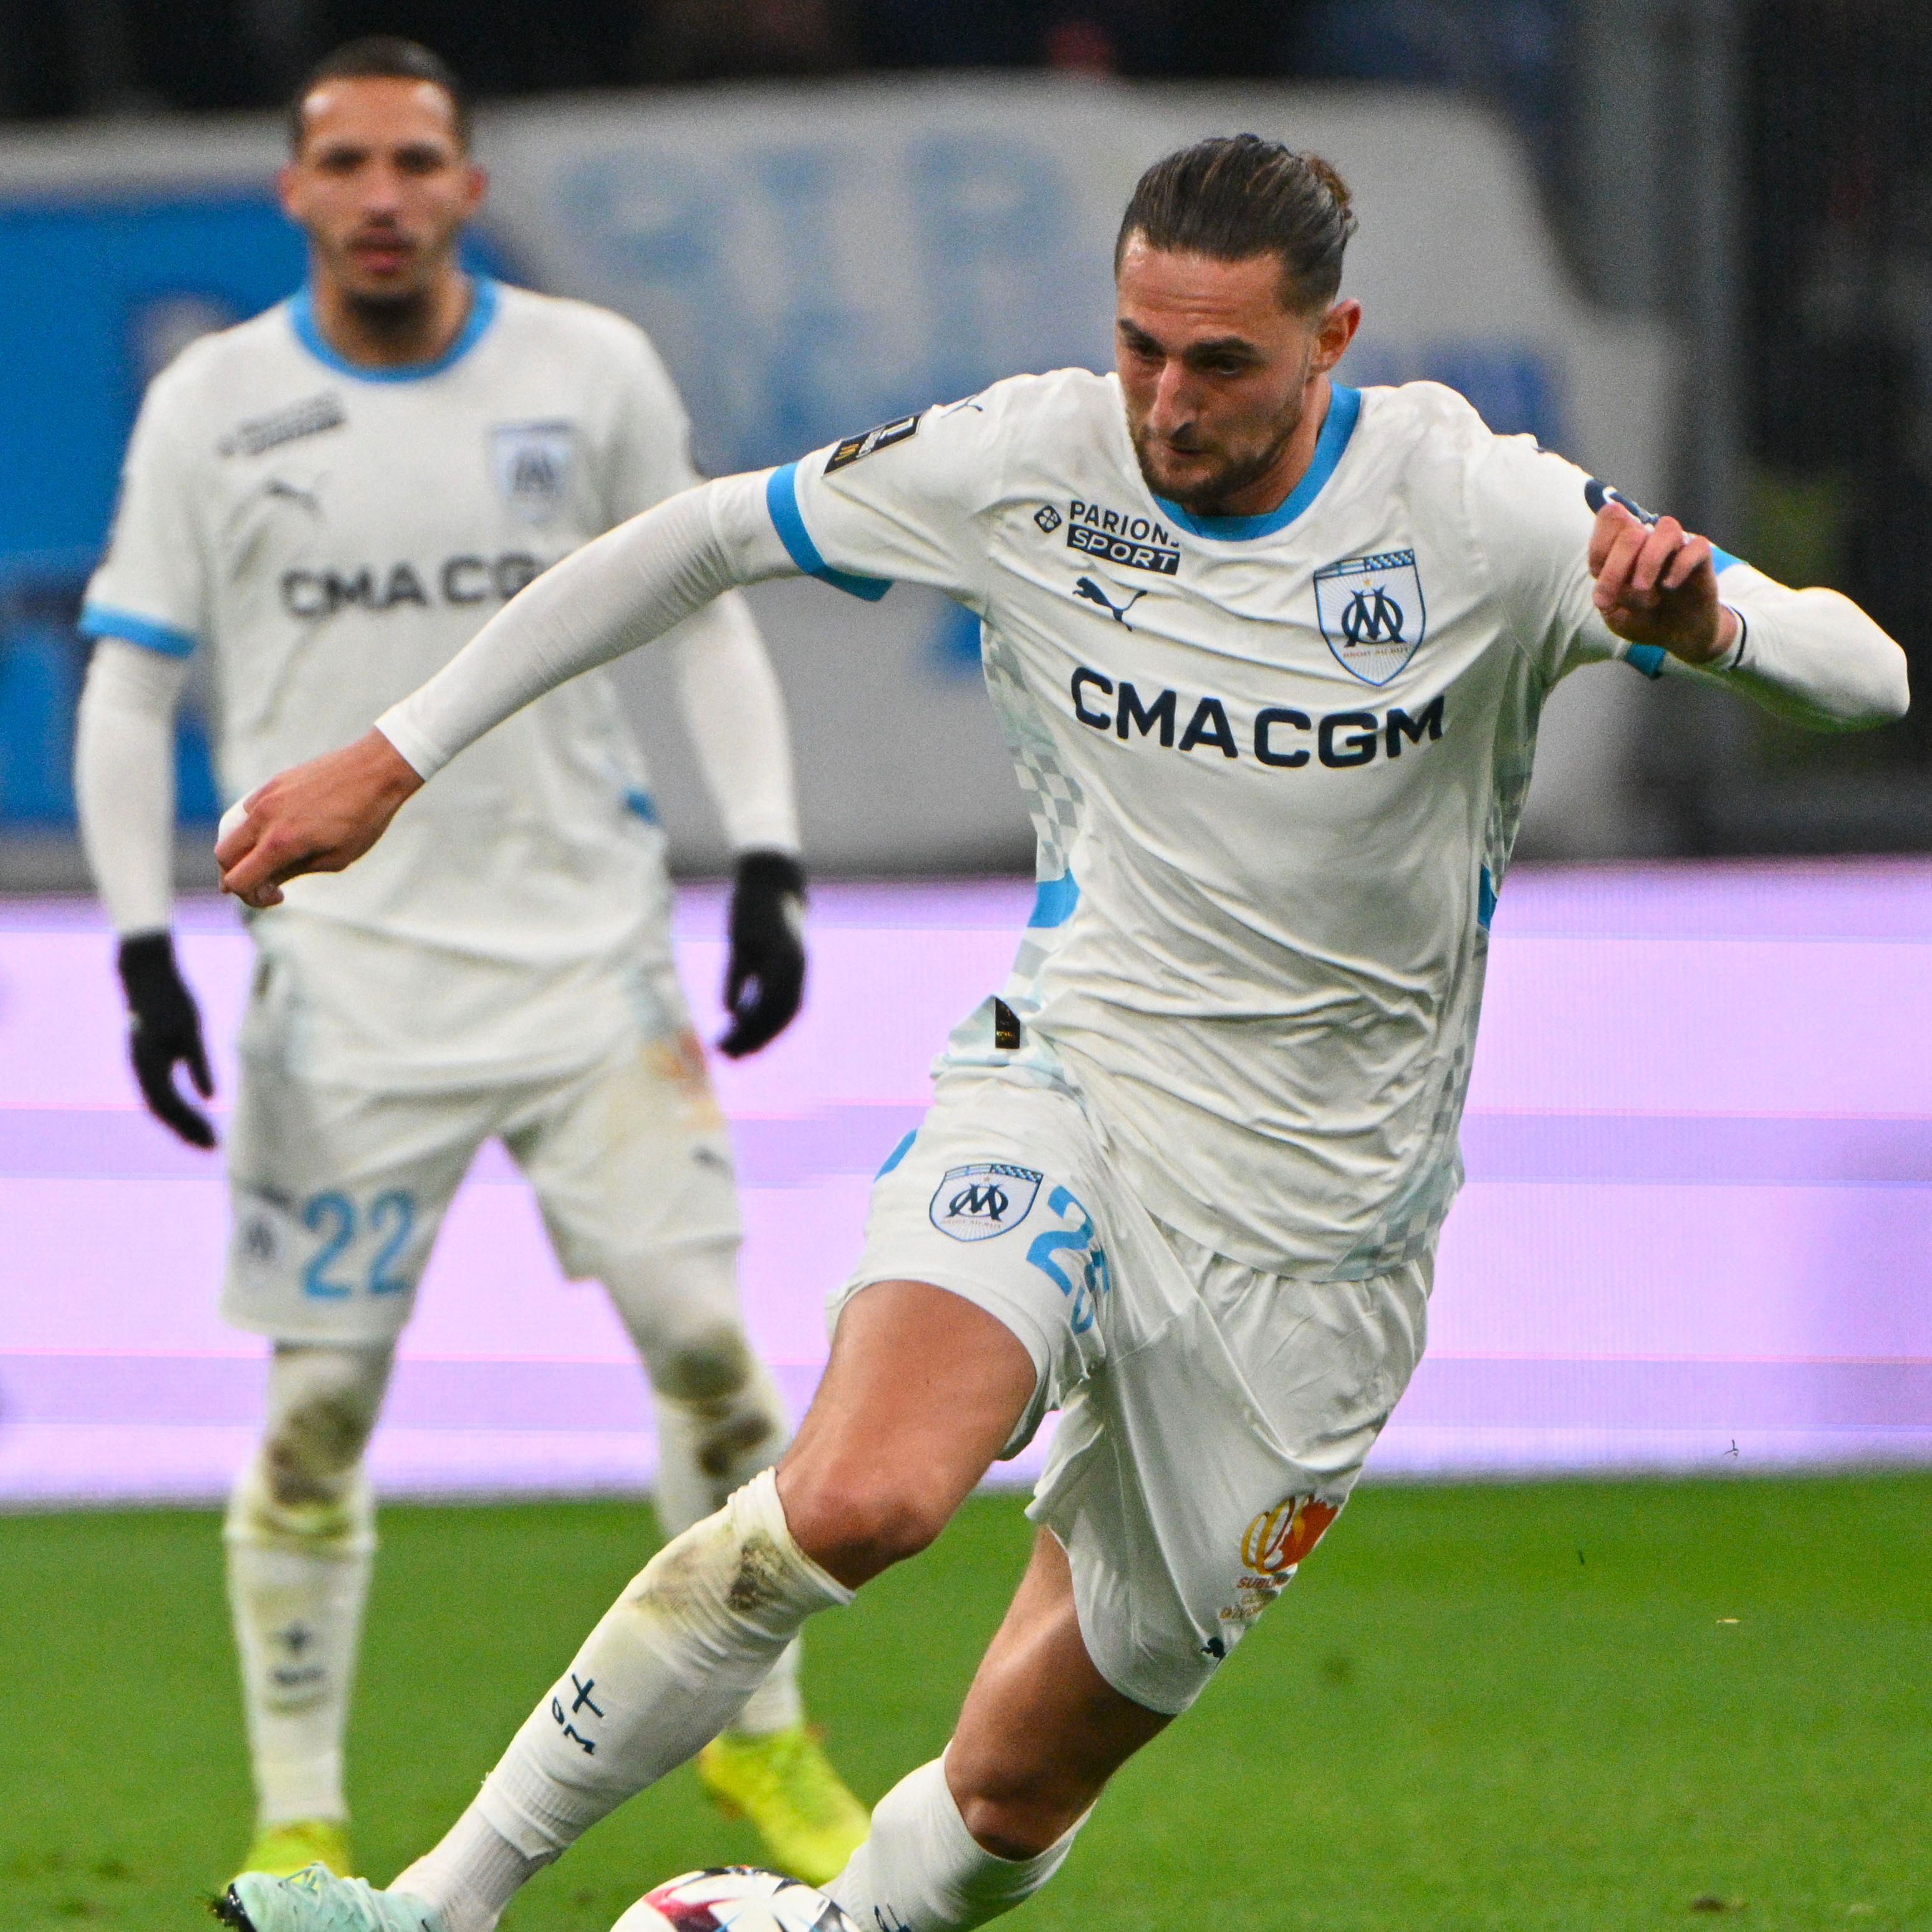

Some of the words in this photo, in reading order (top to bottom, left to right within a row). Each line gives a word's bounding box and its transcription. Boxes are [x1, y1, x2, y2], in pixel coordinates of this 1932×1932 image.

[1070, 499, 1180, 547] PARION
[1072, 528, 1177, 570] SPORT
[280, 562, 429, 618] CMA
[442, 552, 549, 605] CG
[1070, 666, 1239, 759] CMA
[1254, 695, 1444, 768] CGM
[300, 1188, 416, 1299] 22
